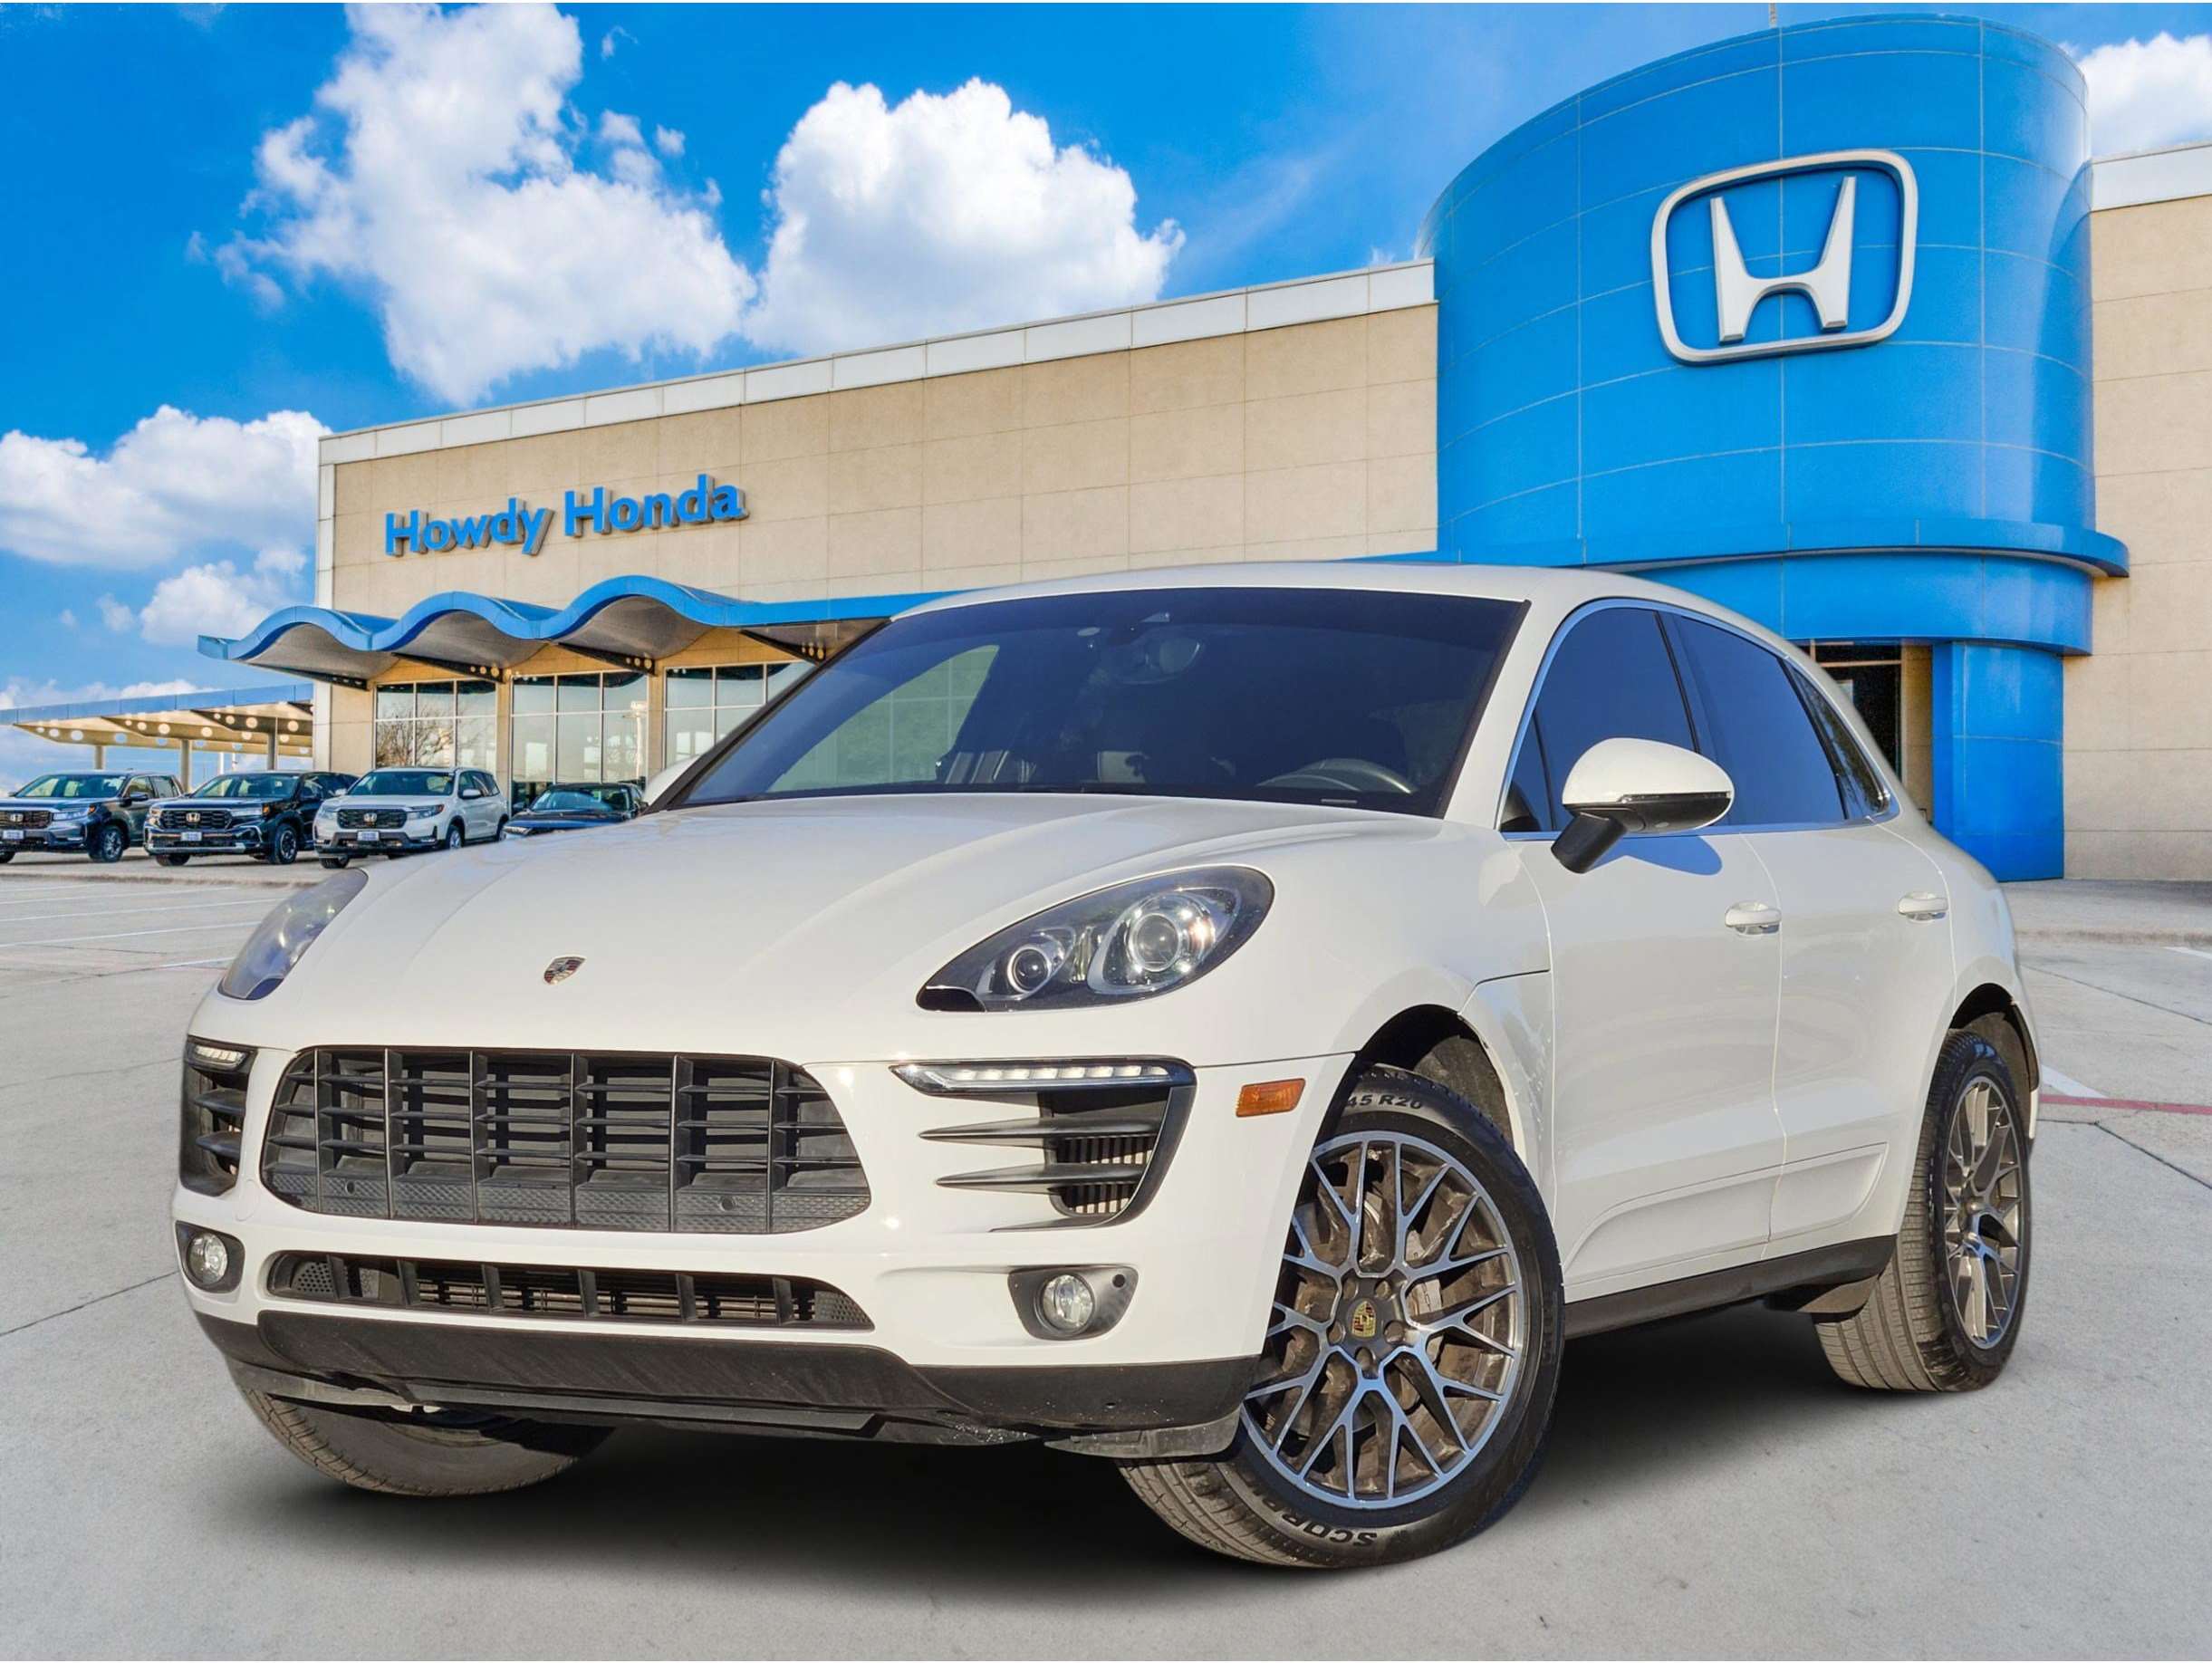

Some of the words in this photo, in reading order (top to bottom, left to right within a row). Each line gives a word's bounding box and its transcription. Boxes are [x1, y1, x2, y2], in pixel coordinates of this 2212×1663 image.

[384, 496, 554, 557] Howdy
[564, 473, 749, 538] Honda
[1252, 1487, 1378, 1547] SCORP
